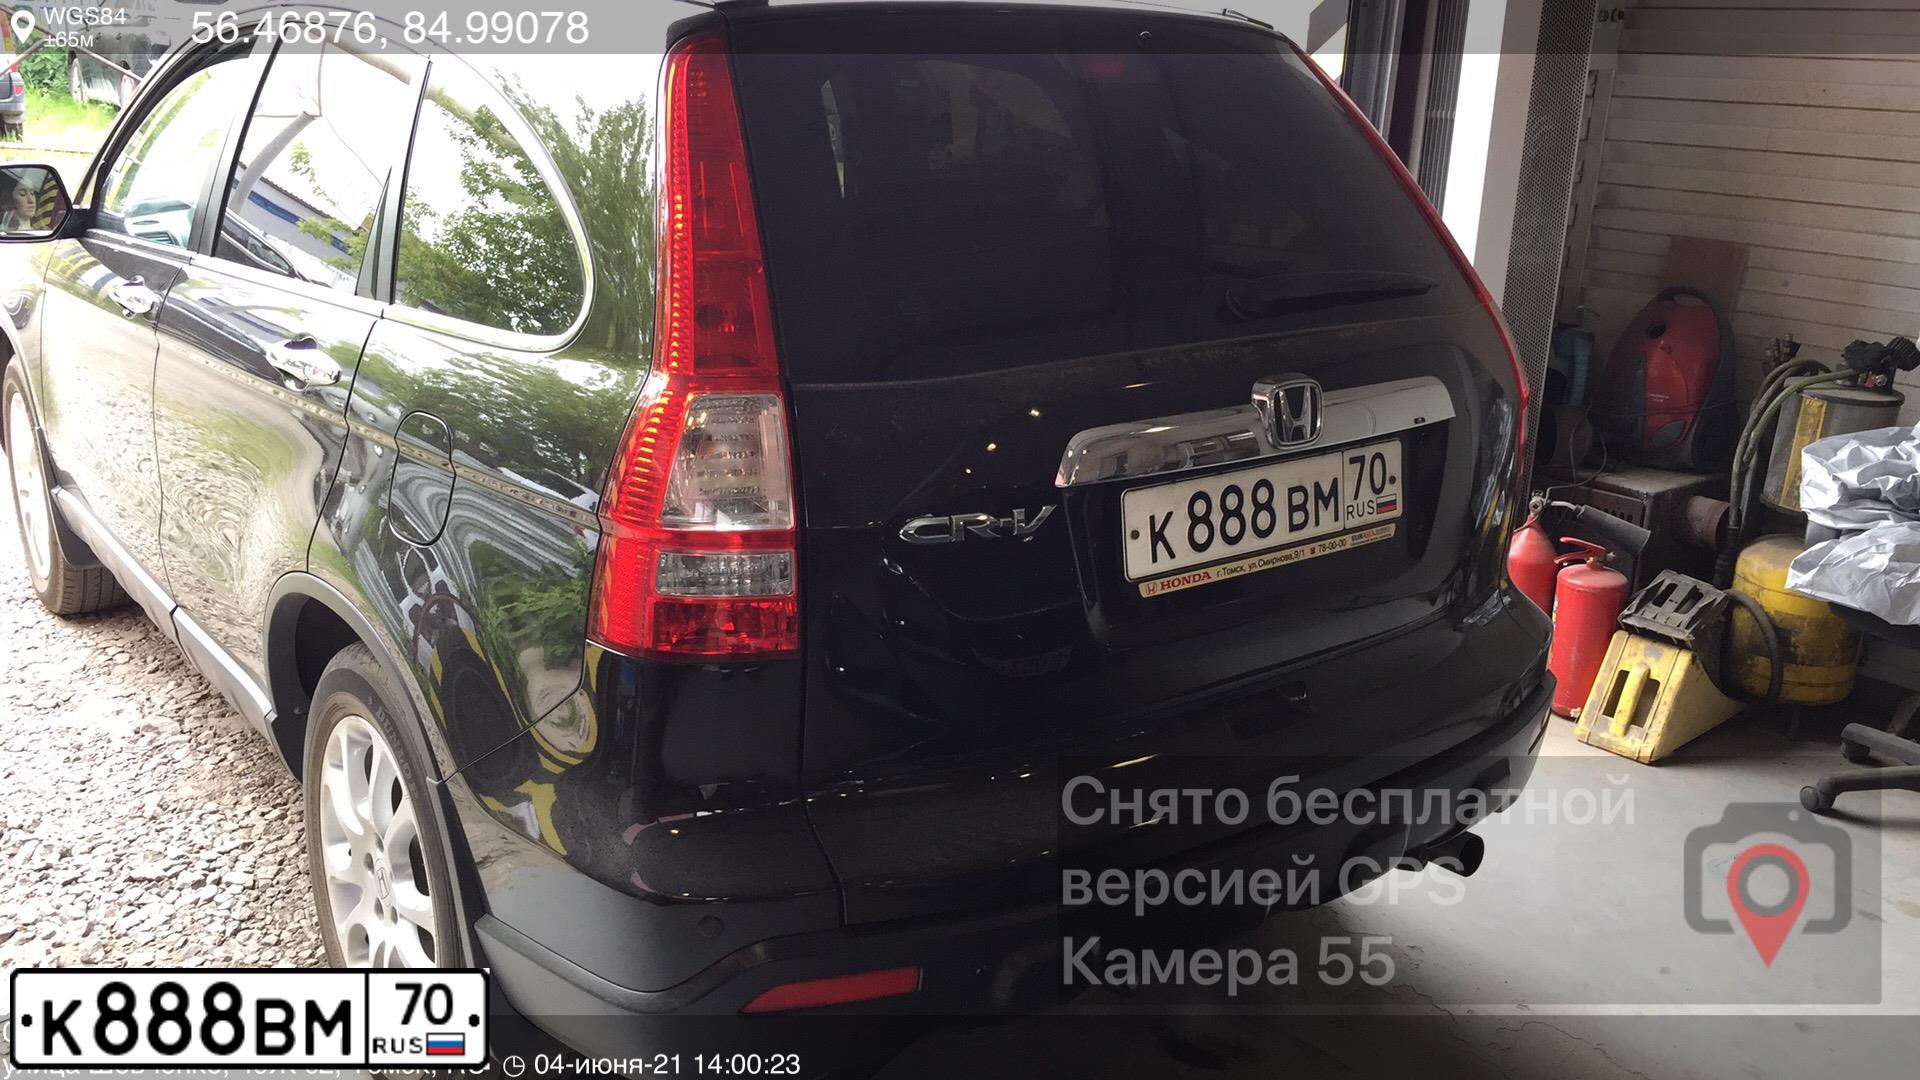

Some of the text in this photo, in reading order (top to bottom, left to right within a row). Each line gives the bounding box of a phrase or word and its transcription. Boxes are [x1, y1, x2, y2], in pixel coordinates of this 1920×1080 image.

[1349, 451, 1387, 501] 70
[899, 504, 1058, 545] CR-V
[1346, 500, 1376, 520] RUS
[1160, 571, 1212, 591] HONDA
